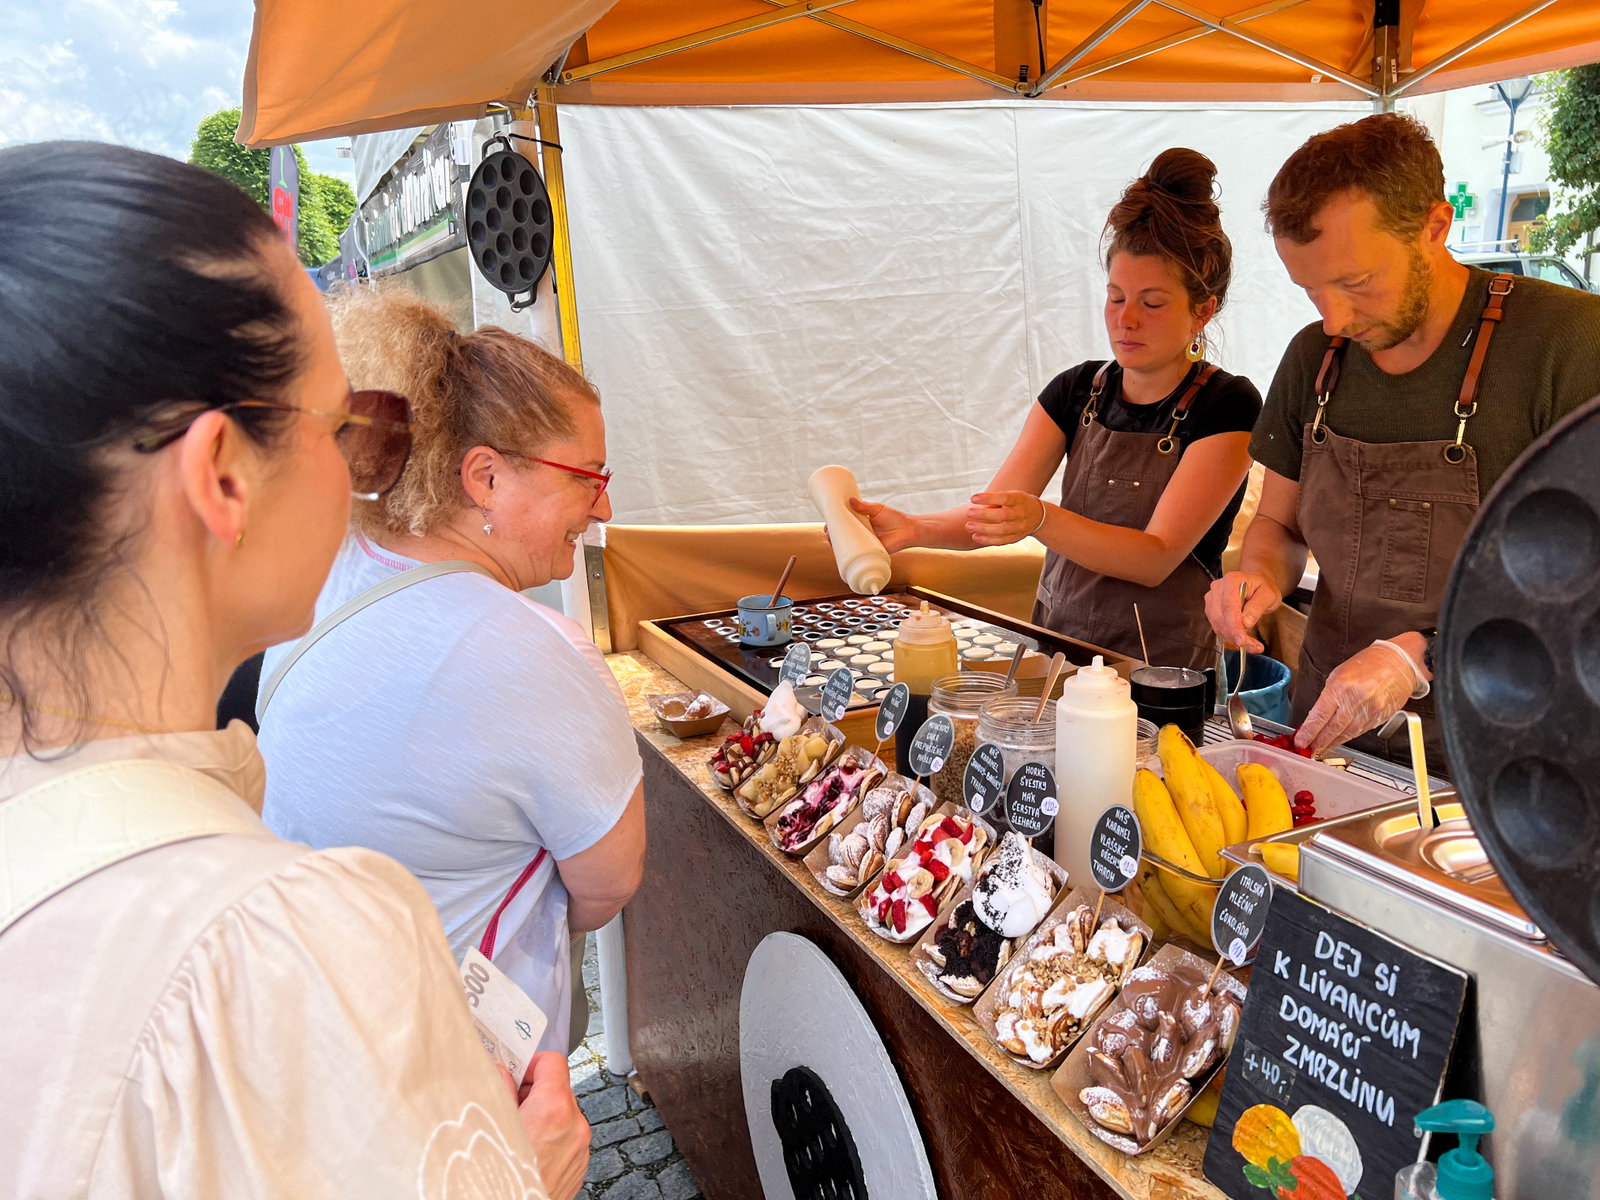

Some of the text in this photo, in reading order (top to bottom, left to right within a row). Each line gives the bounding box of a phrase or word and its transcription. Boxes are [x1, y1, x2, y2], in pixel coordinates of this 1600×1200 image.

[1019, 775, 1047, 791] ŠVESTKY
[1025, 765, 1046, 779] HORKÉ
[1105, 817, 1131, 842] KARAMEL
[1093, 859, 1116, 883] TVAROH
[1239, 875, 1268, 898] ITALSKÁ
[1228, 890, 1258, 915] MLÉČNÁ
[1219, 907, 1250, 939] ČOKOLÁDA
[1314, 930, 1362, 978] DEJ
[1273, 950, 1421, 1060] K LÍVANCŮM
[1279, 994, 1371, 1060] DOMÁCÍ
